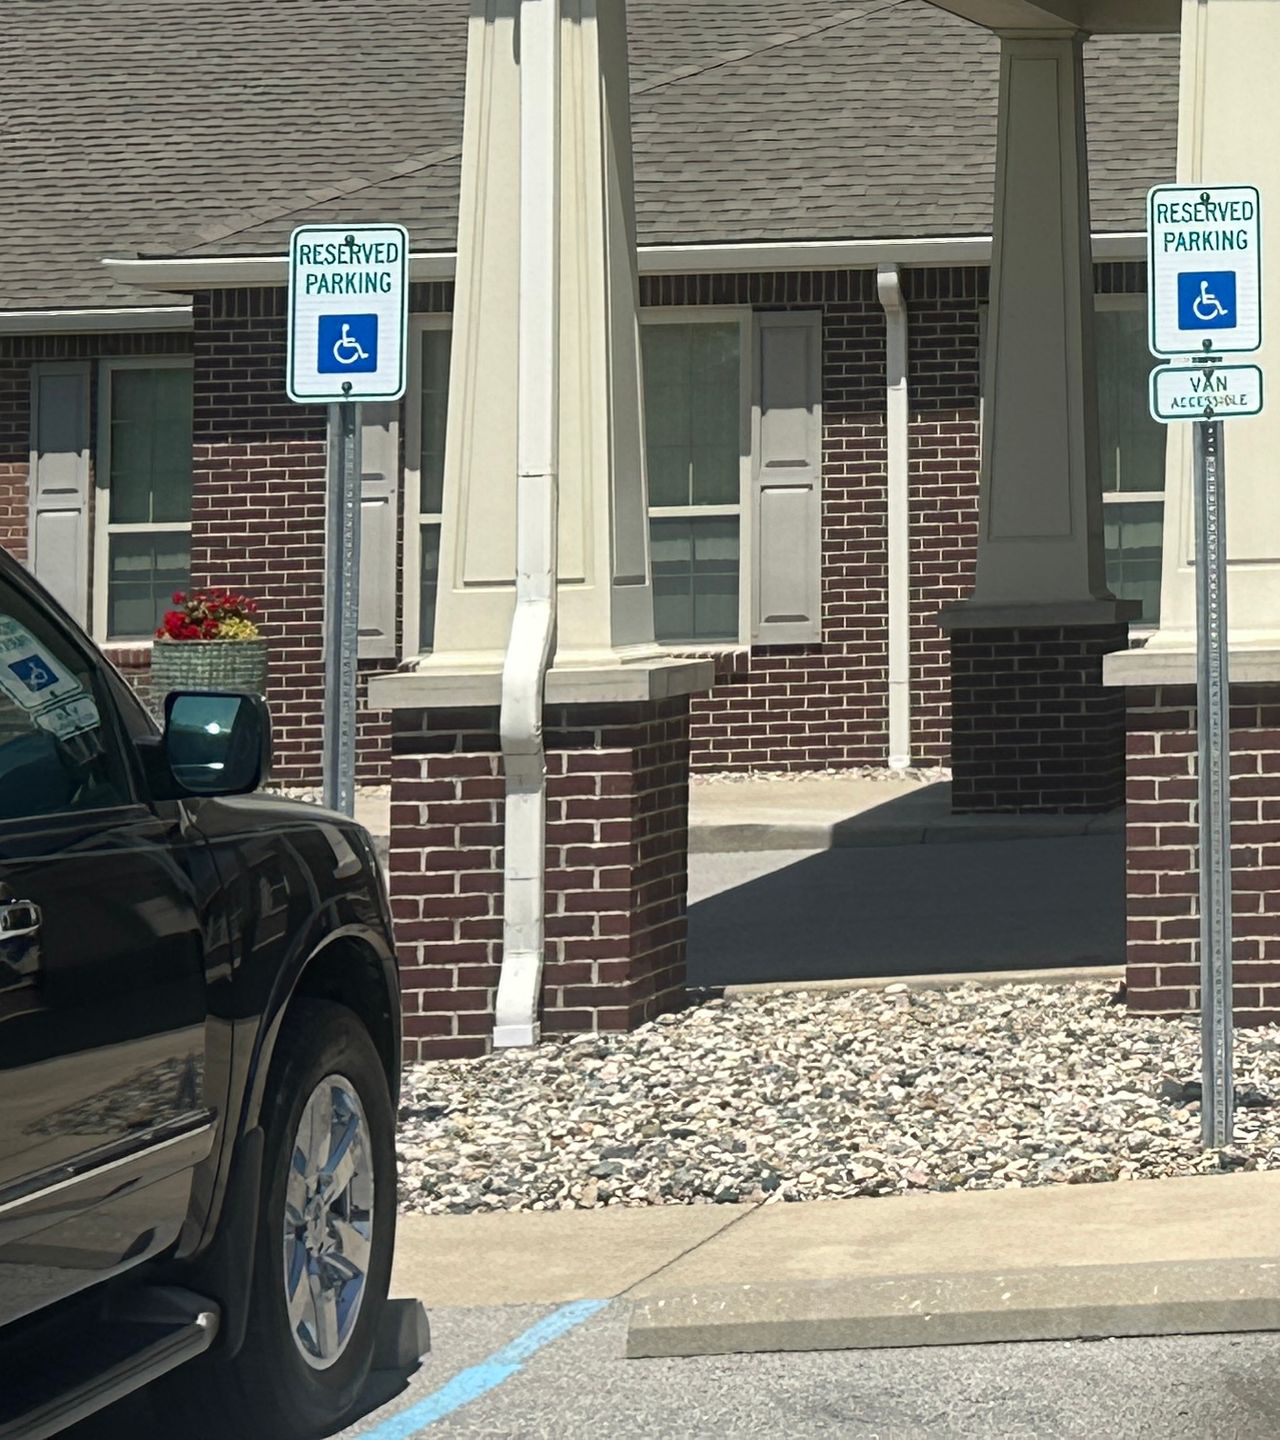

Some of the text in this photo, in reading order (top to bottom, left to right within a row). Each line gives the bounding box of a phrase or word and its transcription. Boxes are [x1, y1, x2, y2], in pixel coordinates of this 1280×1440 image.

[1157, 201, 1254, 224] RESERVED
[1163, 229, 1248, 252] PARKING
[299, 242, 399, 265] RESERVED
[305, 271, 392, 295] PARKING
[1189, 375, 1228, 393] VAN
